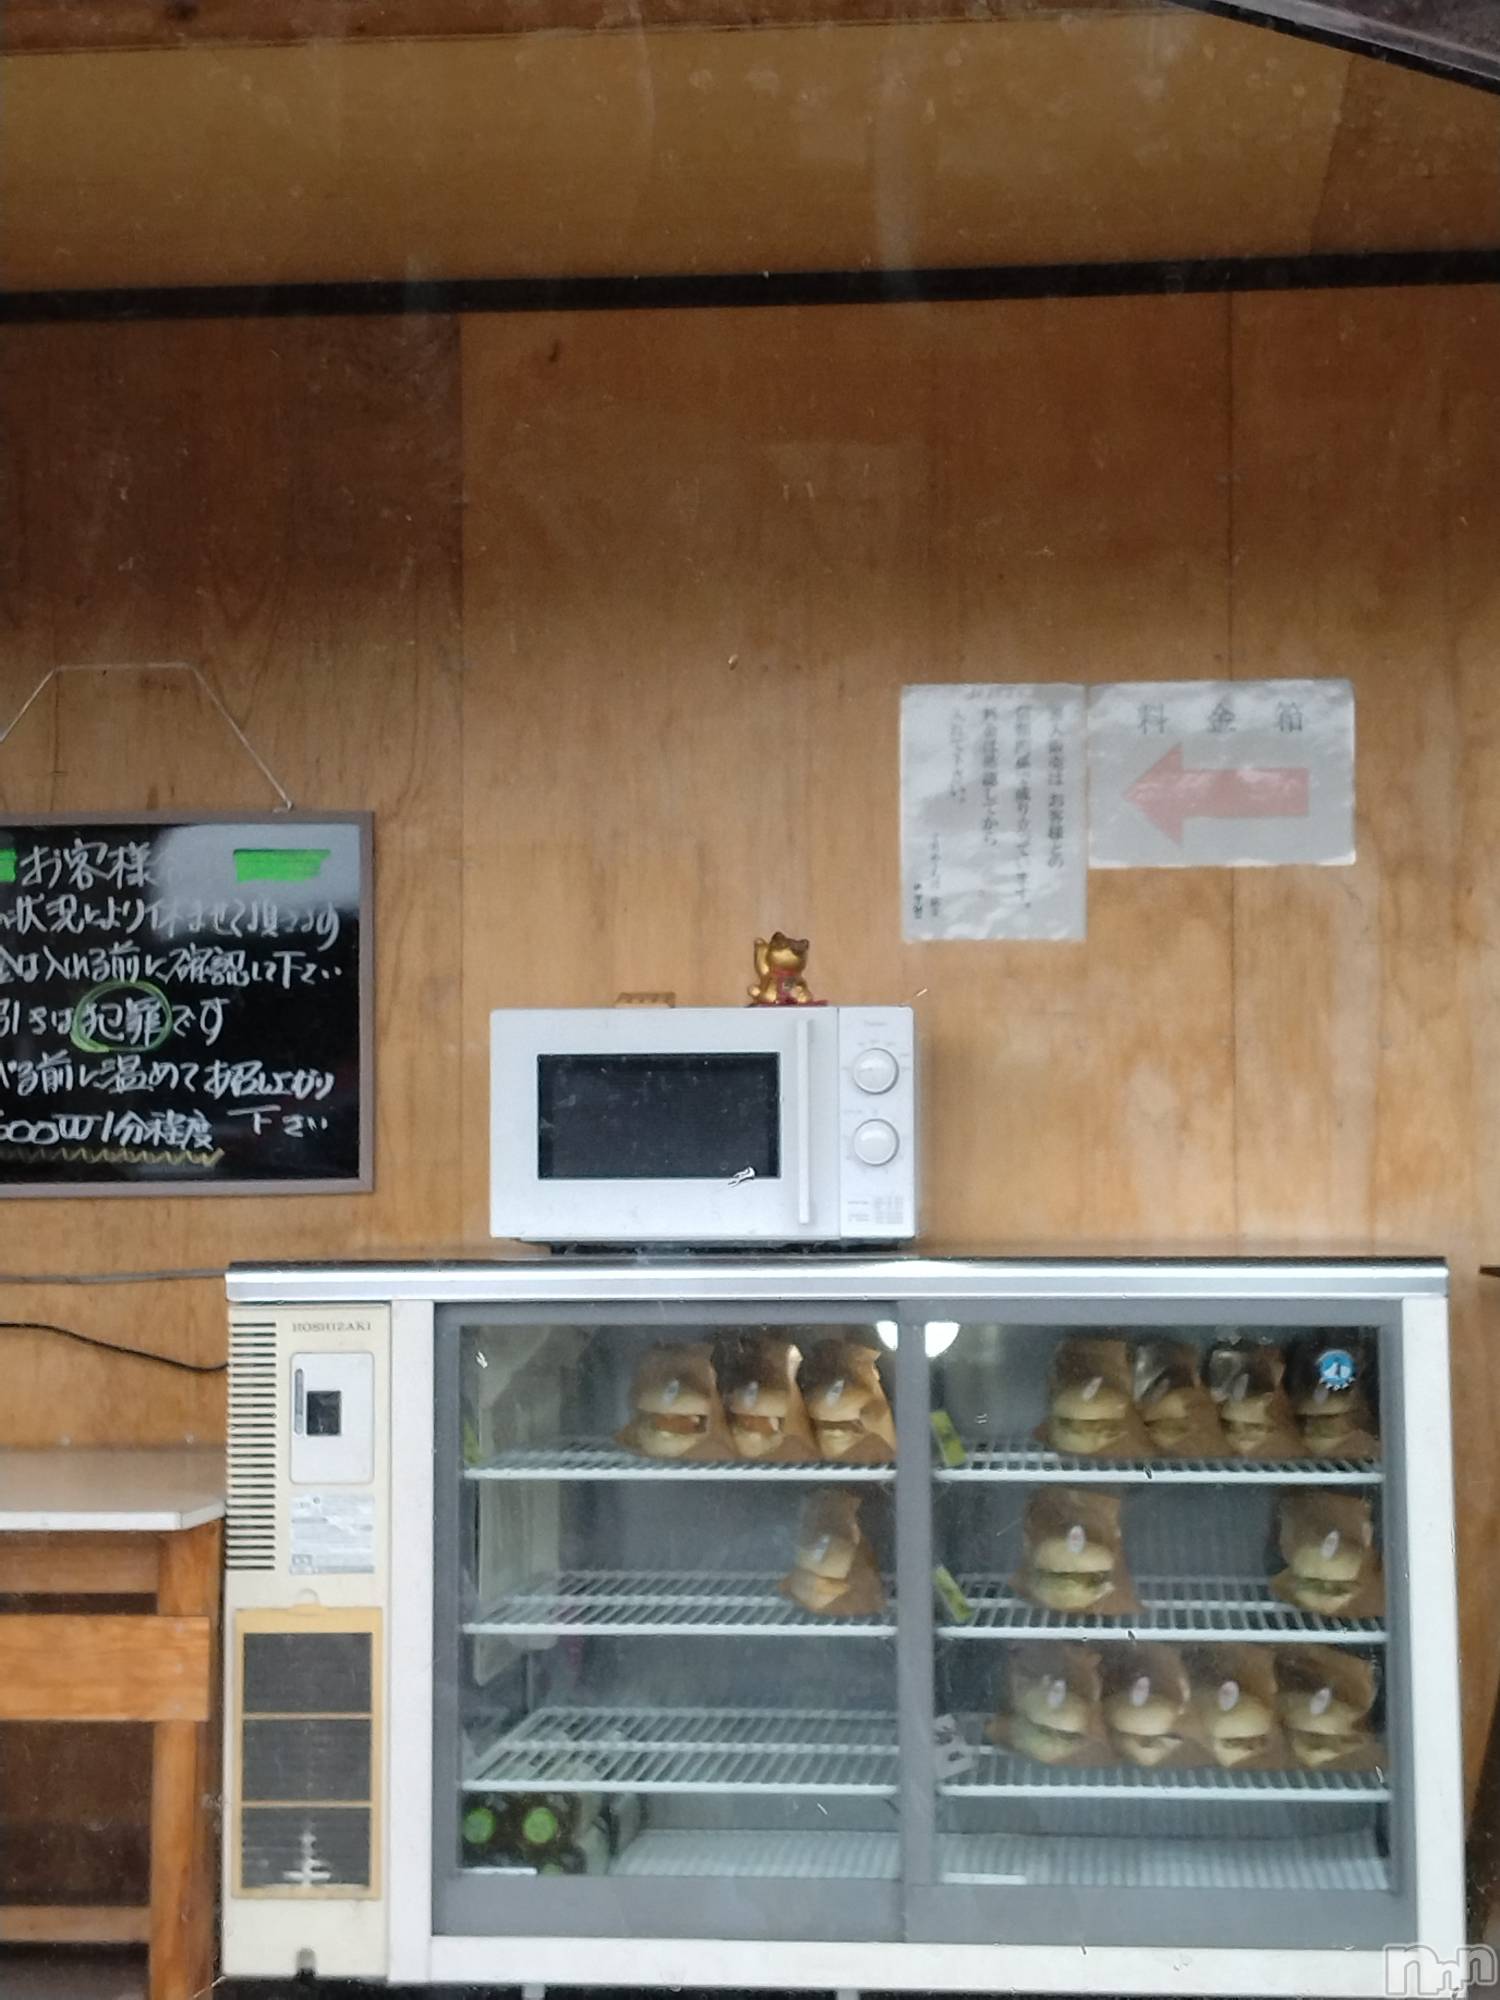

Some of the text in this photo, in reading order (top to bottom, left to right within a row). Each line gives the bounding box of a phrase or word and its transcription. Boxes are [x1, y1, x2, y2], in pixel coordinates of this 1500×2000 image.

[20, 838, 158, 888] お客様
[227, 1104, 329, 1138] 下さい
[292, 1321, 371, 1333] HOSHIZAKI
